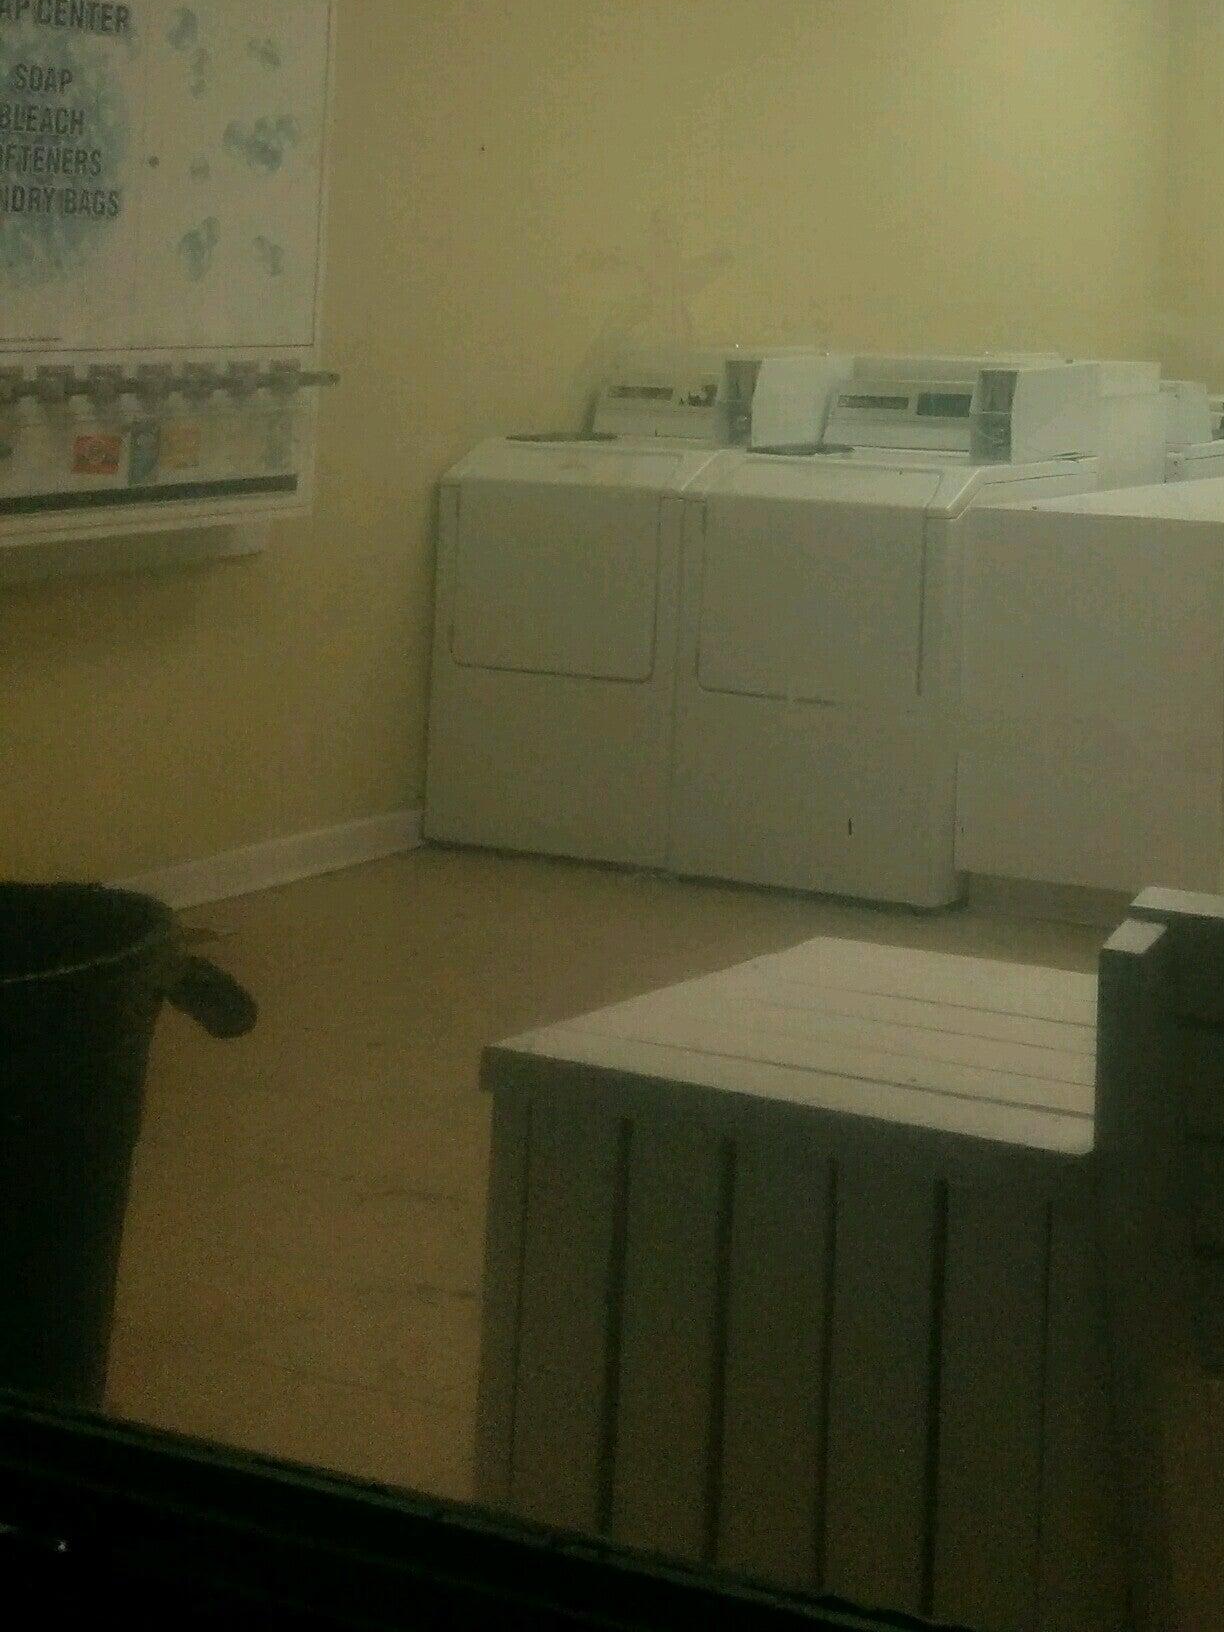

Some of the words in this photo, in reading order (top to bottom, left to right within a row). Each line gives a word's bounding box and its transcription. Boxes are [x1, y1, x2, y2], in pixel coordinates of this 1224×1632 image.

[14, 63, 74, 94] SOAP
[0, 103, 85, 136] BLEACH
[0, 144, 103, 177] FTENERS
[63, 187, 120, 218] BAGS
